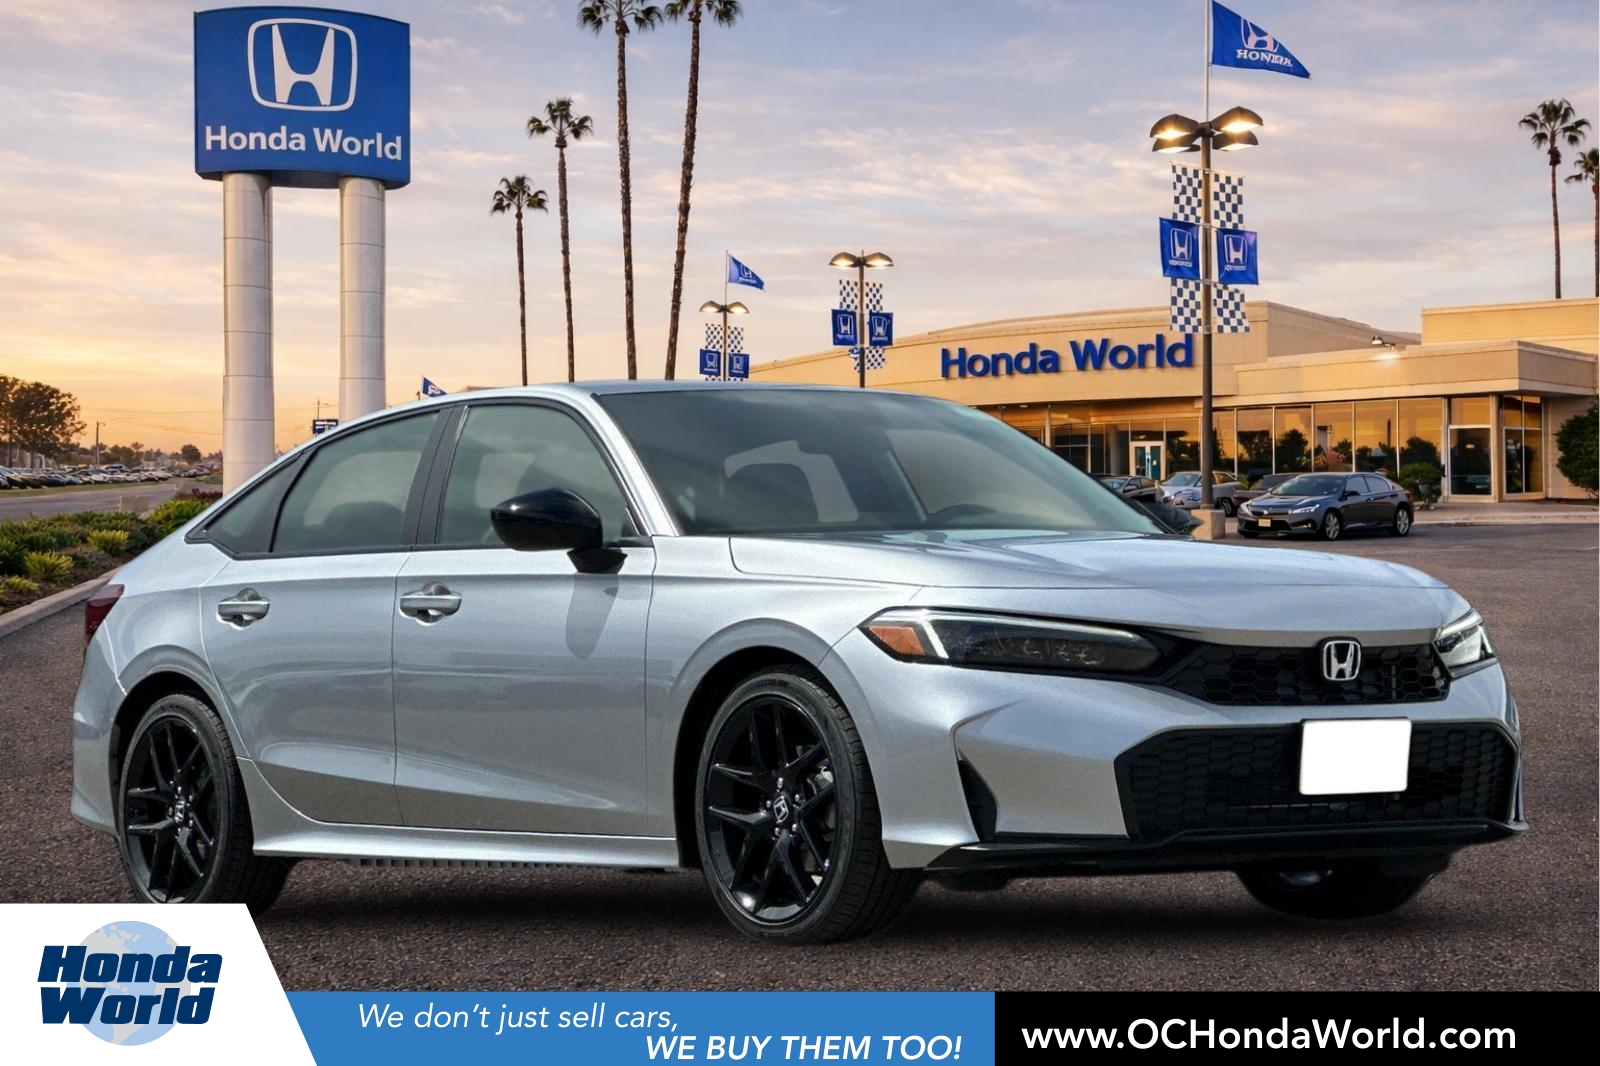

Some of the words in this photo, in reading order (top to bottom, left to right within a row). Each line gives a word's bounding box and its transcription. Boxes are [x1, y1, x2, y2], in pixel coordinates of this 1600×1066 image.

[205, 125, 306, 151] Honda
[312, 127, 402, 161] World
[940, 342, 1059, 378] Honda
[1069, 333, 1194, 371] World
